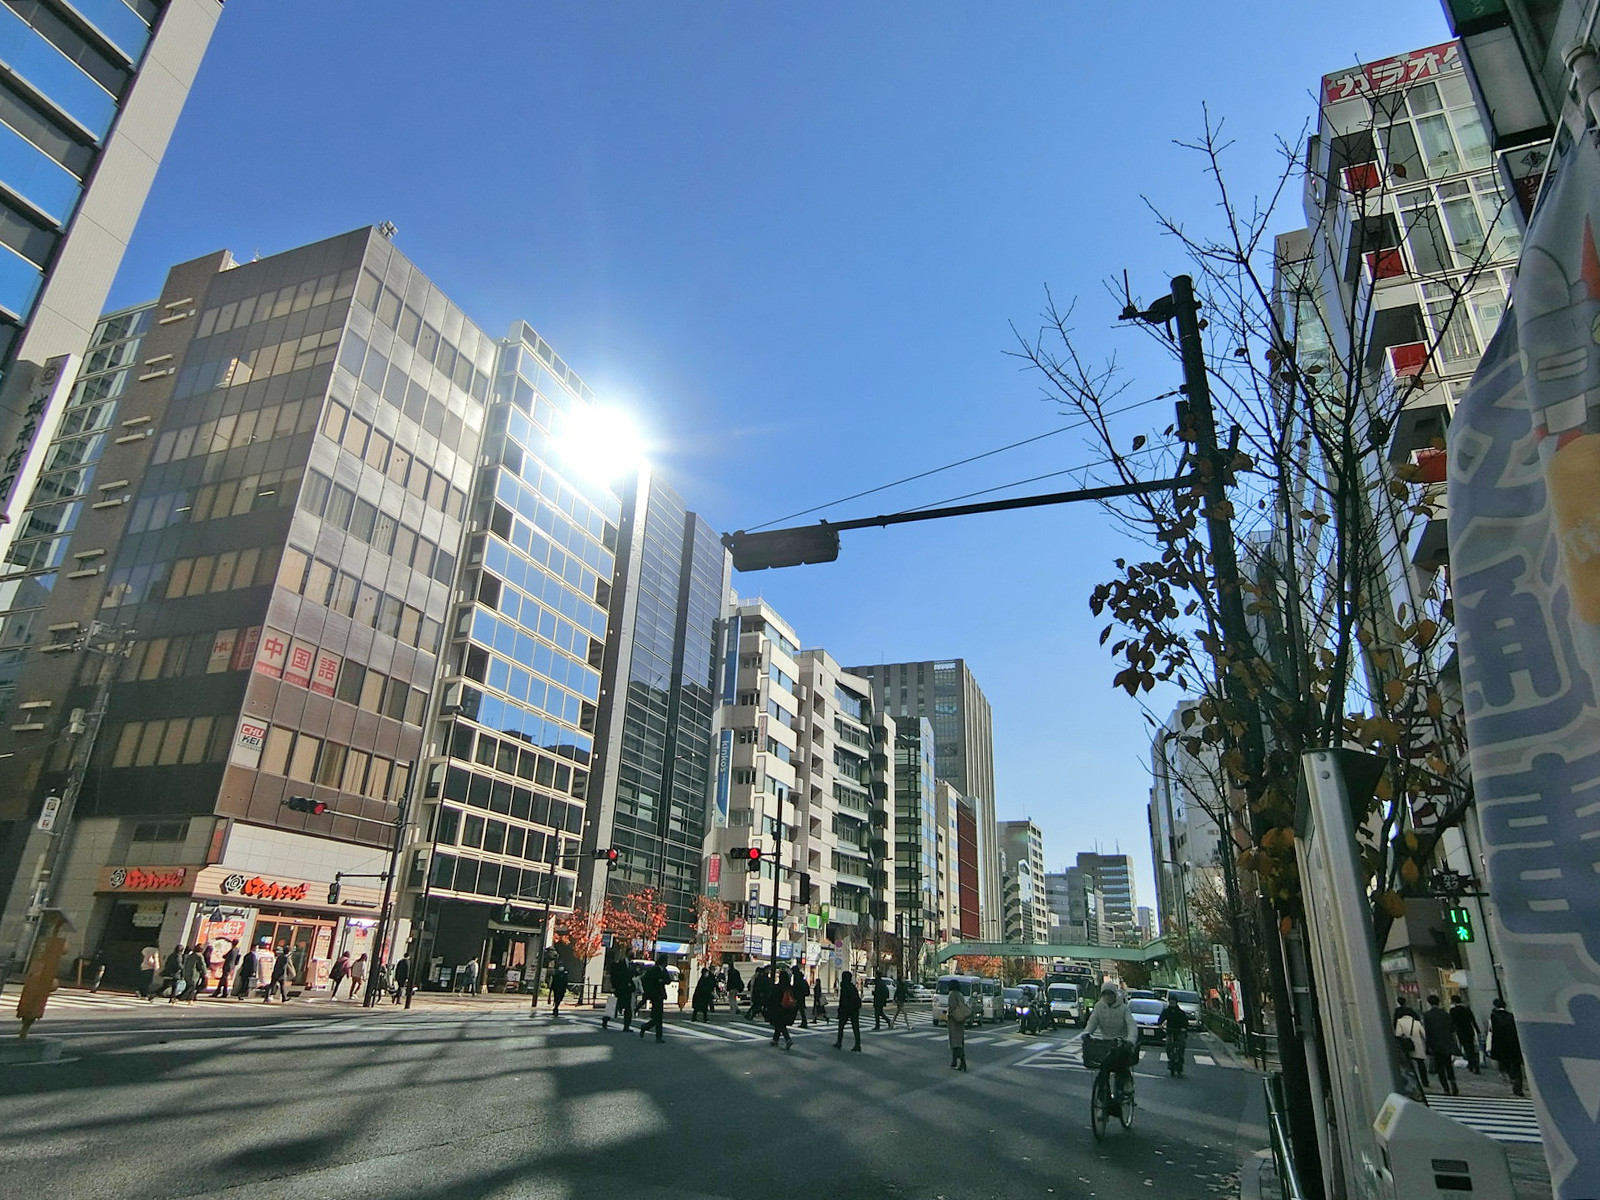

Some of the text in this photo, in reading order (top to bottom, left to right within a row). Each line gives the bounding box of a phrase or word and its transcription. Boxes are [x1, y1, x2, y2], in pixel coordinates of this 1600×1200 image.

[264, 637, 337, 681] 中国語
[241, 725, 264, 738] CHU
[242, 736, 259, 746] KEI
